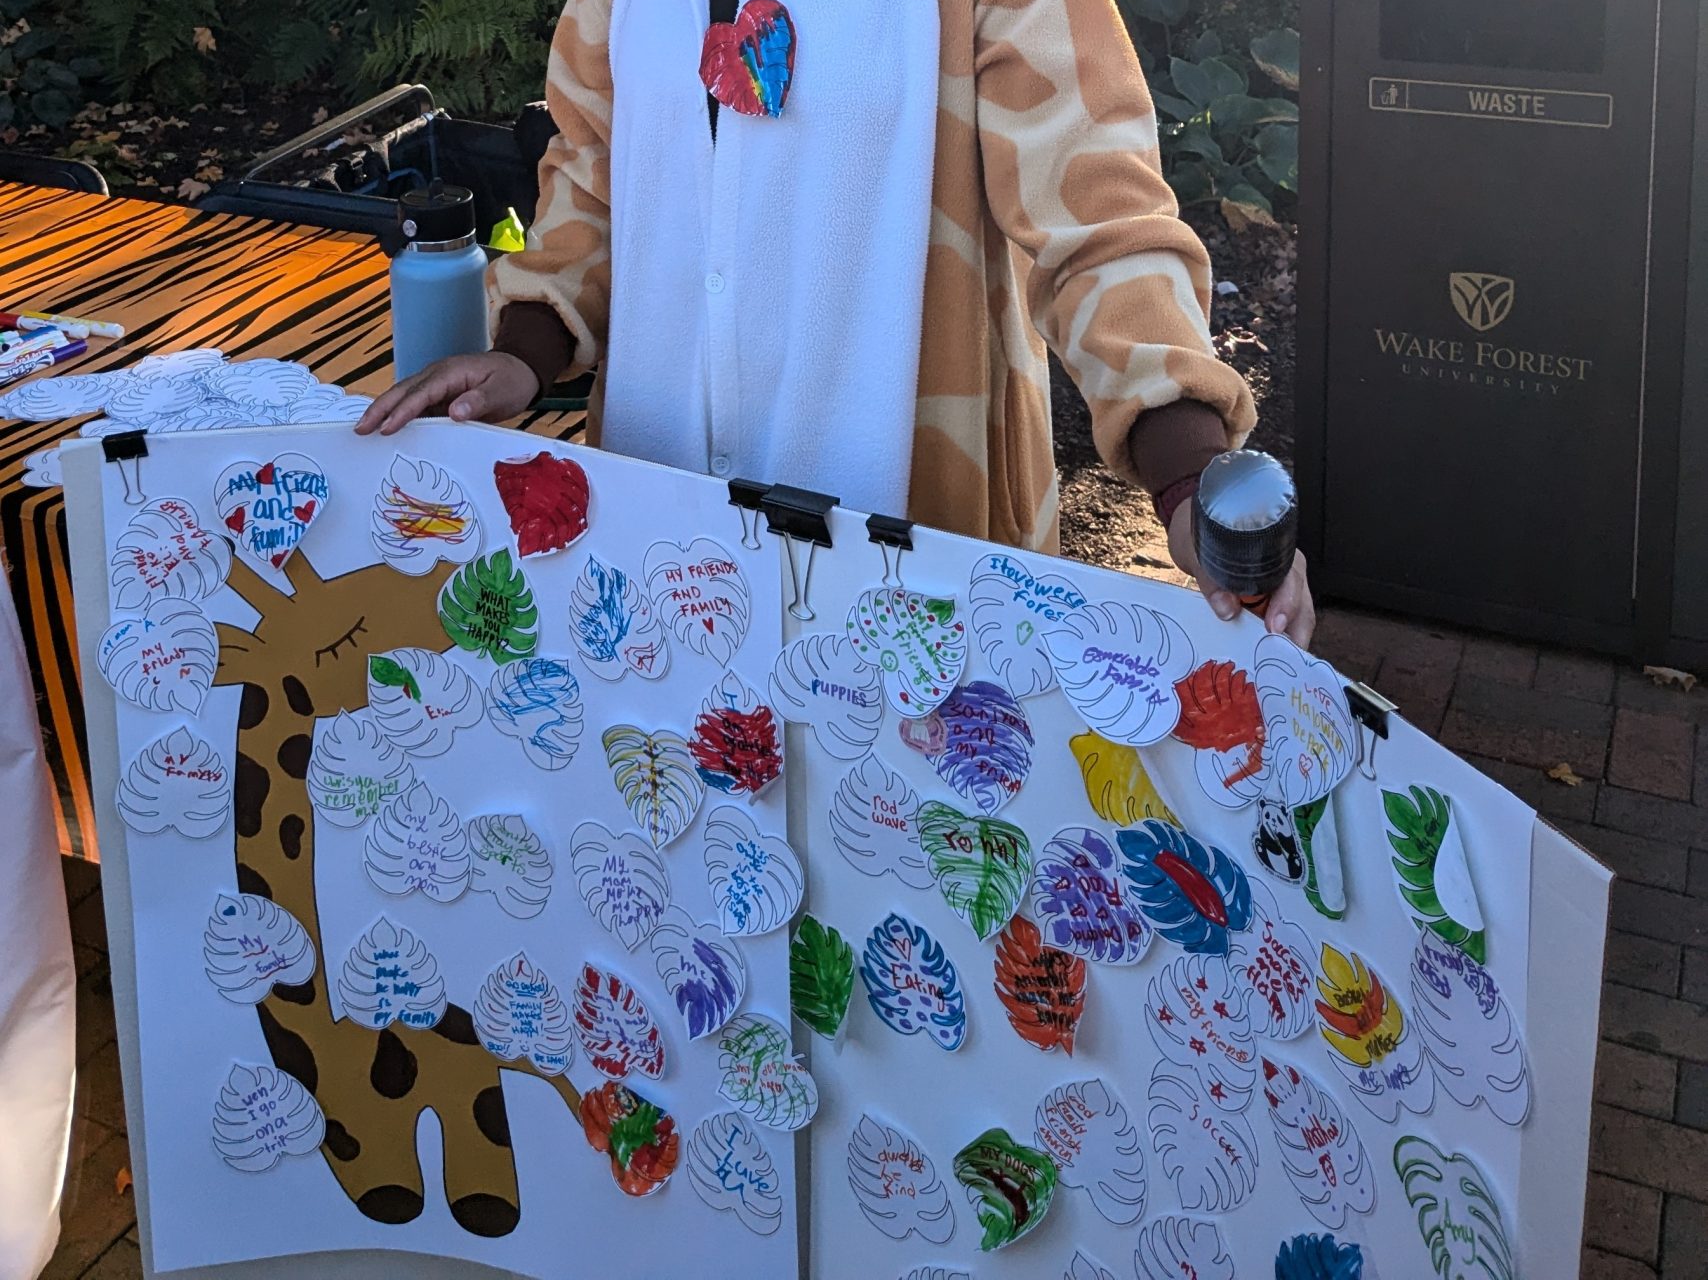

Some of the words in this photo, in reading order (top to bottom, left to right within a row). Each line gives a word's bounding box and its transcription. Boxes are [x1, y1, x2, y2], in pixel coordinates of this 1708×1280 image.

[1468, 89, 1546, 116] WASTE
[1375, 328, 1464, 363] WAKE
[1476, 341, 1593, 381] FOREST
[1401, 364, 1561, 395] UNIVERSITY
[665, 569, 684, 584] MY
[687, 561, 738, 579] FRIENDS
[481, 588, 512, 612] WHAT
[672, 585, 702, 602] AND
[475, 601, 511, 626] MAKES
[679, 596, 732, 617] FAMILY
[467, 622, 510, 655] HAPPY?
[484, 617, 501, 636] YOU
[811, 679, 867, 708] PUPPIES
[872, 794, 898, 815] rod
[872, 811, 908, 833] wave
[890, 963, 947, 1013] Eating
[258, 1099, 277, 1118] go
[1005, 1153, 1036, 1184] DOGS
